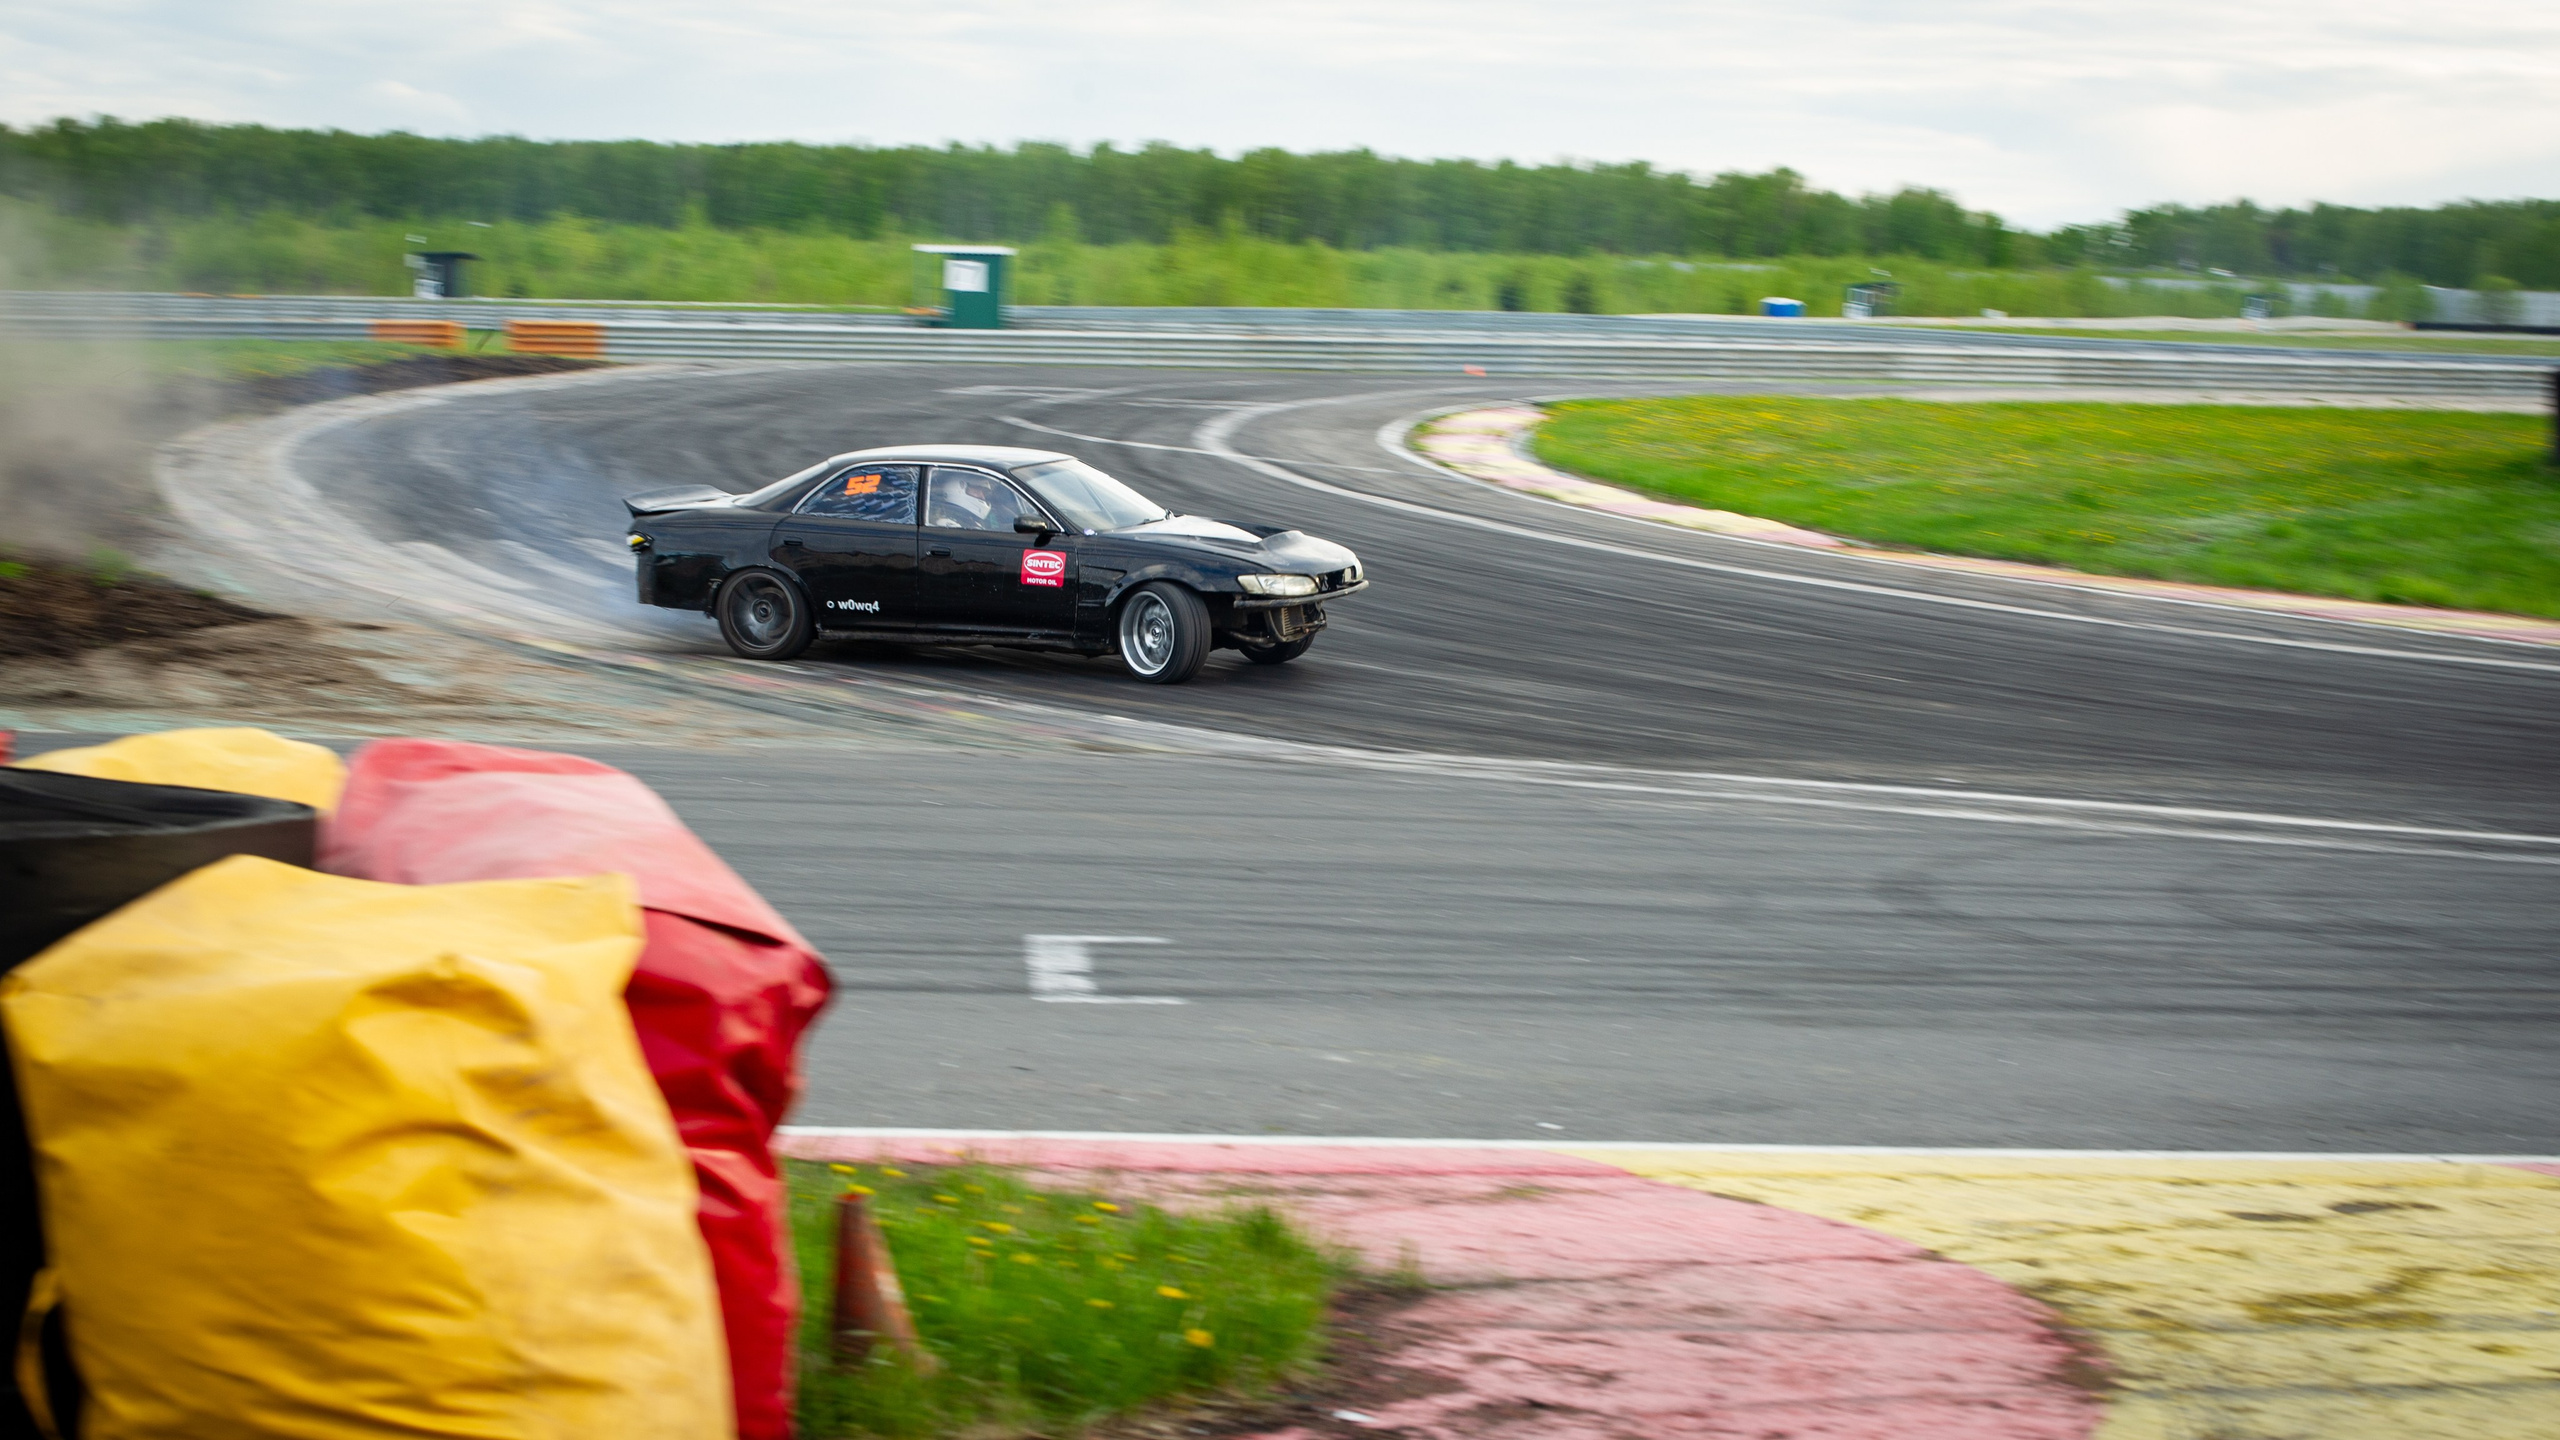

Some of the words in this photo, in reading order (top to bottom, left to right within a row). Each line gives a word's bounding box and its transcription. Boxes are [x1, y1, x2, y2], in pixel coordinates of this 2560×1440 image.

[844, 474, 882, 496] 52
[1026, 558, 1061, 570] SINTEC
[1026, 577, 1047, 585] MOTOR
[837, 599, 880, 614] w0wq4
